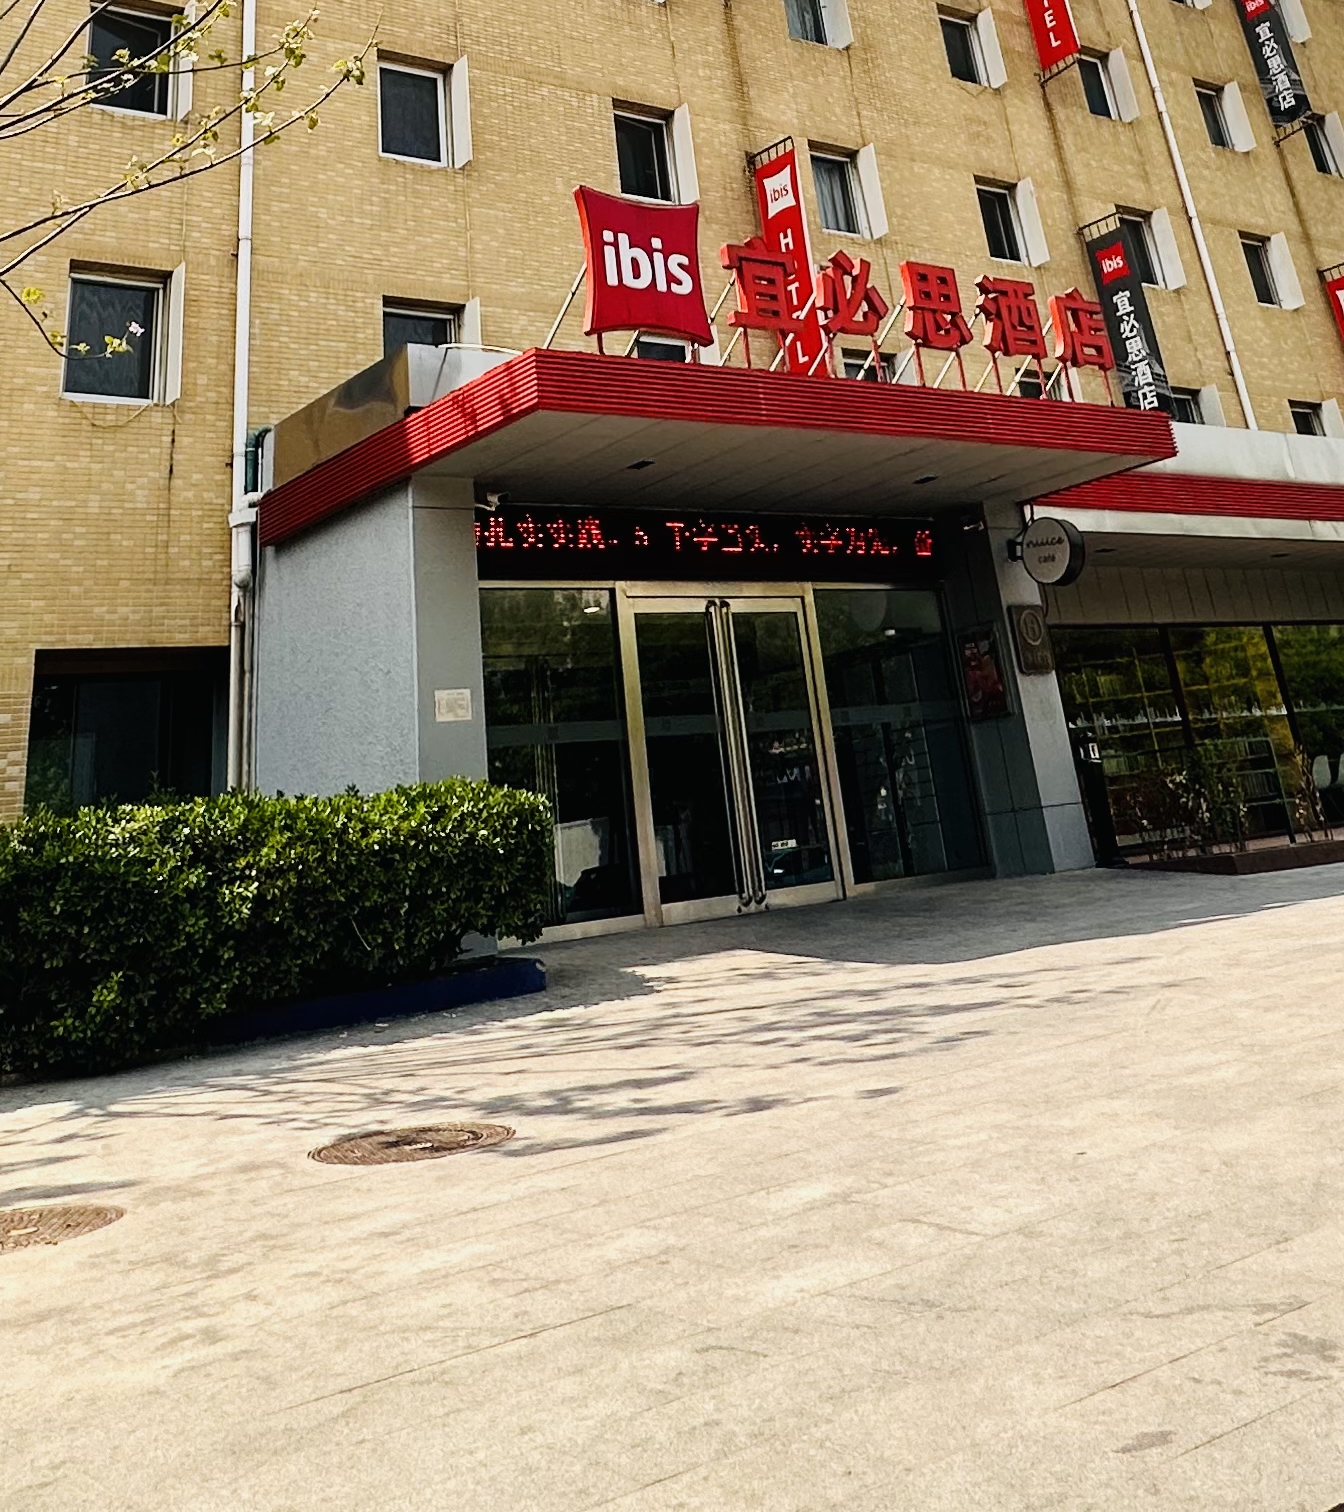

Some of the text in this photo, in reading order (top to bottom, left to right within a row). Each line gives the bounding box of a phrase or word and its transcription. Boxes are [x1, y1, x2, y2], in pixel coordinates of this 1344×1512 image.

[1255, 21, 1296, 112] 宜必思酒店
[769, 183, 789, 203] ibis
[602, 229, 693, 296] ibis
[720, 236, 1116, 373] 宜必思酒店
[779, 228, 809, 364] HTL
[1112, 290, 1159, 411] 宜必思酒店
